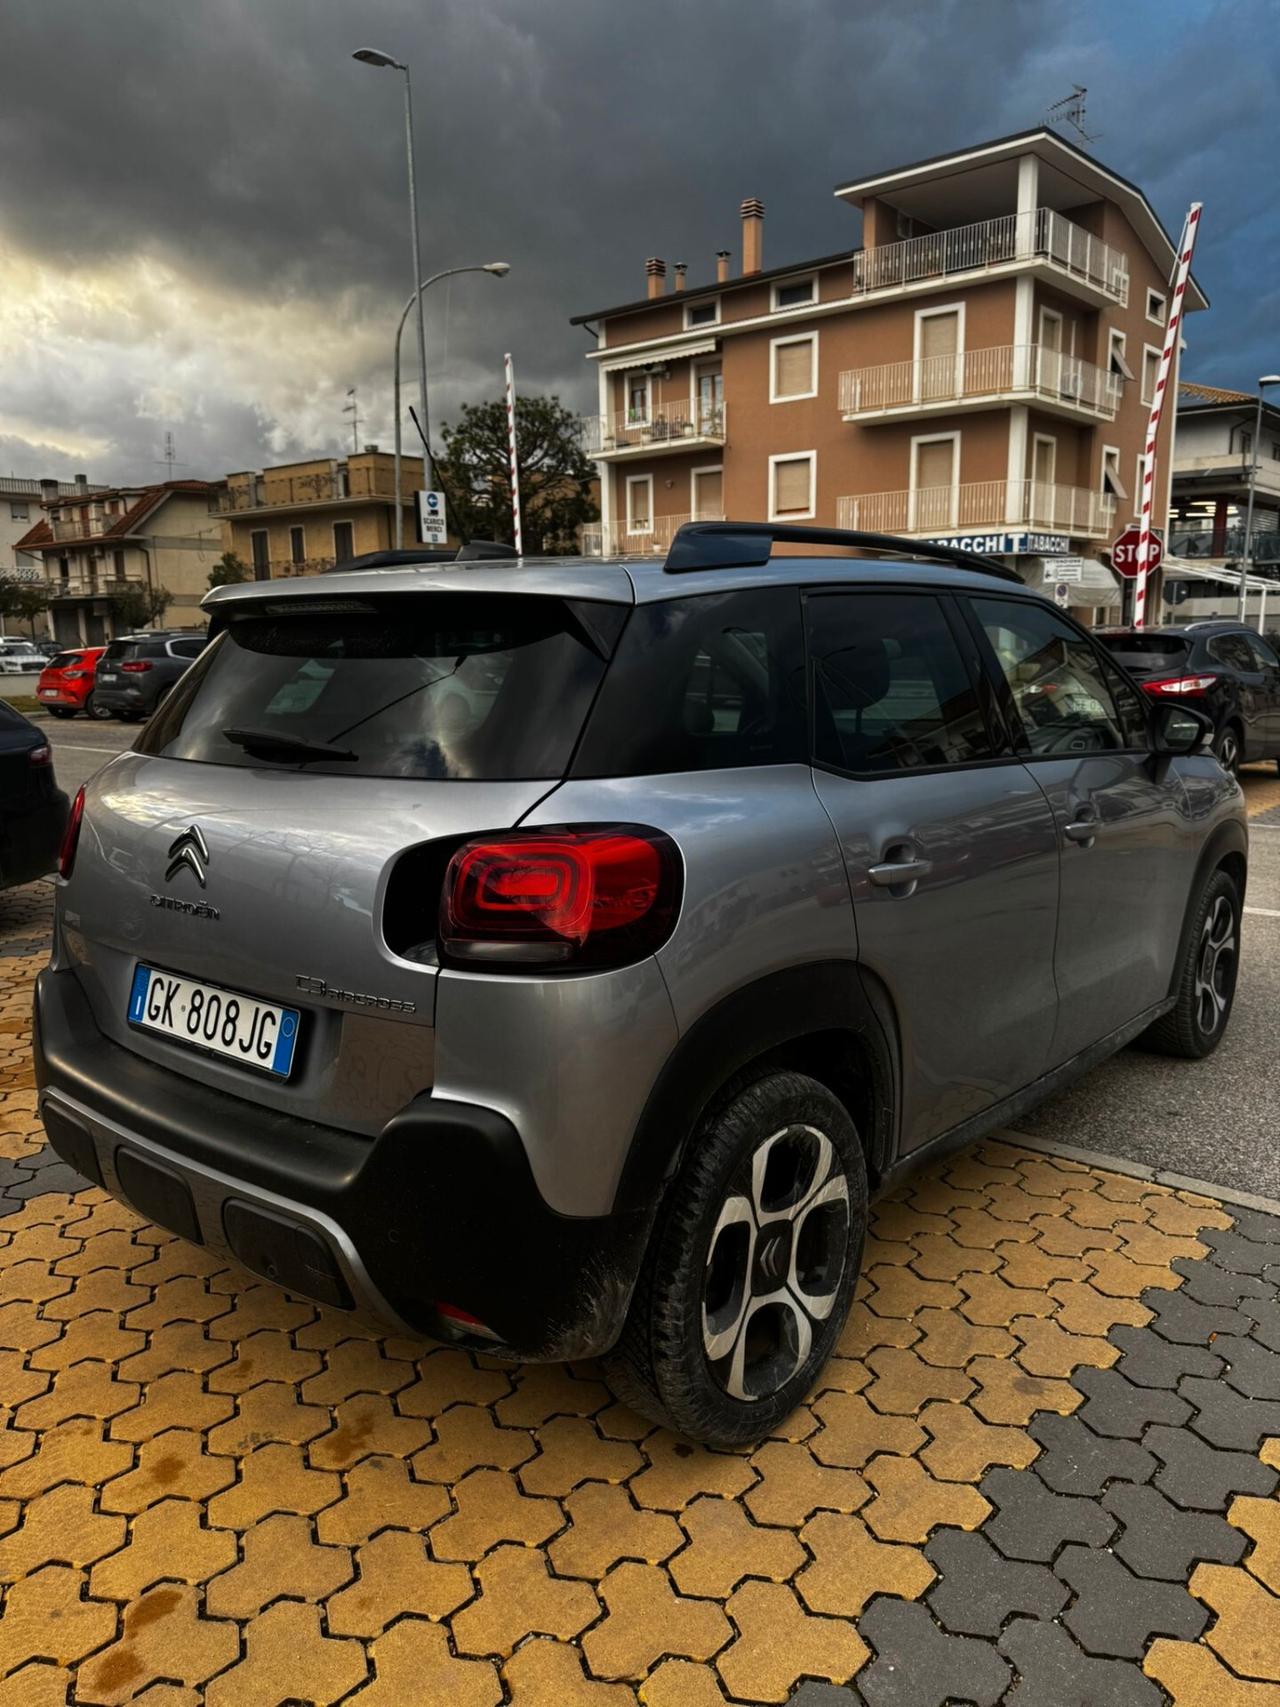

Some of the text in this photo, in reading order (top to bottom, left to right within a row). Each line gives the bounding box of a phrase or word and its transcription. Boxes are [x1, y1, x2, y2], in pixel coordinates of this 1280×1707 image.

[1007, 533, 1025, 553] T
[1029, 534, 1068, 553] TABACCHI
[296, 974, 326, 995] C3
